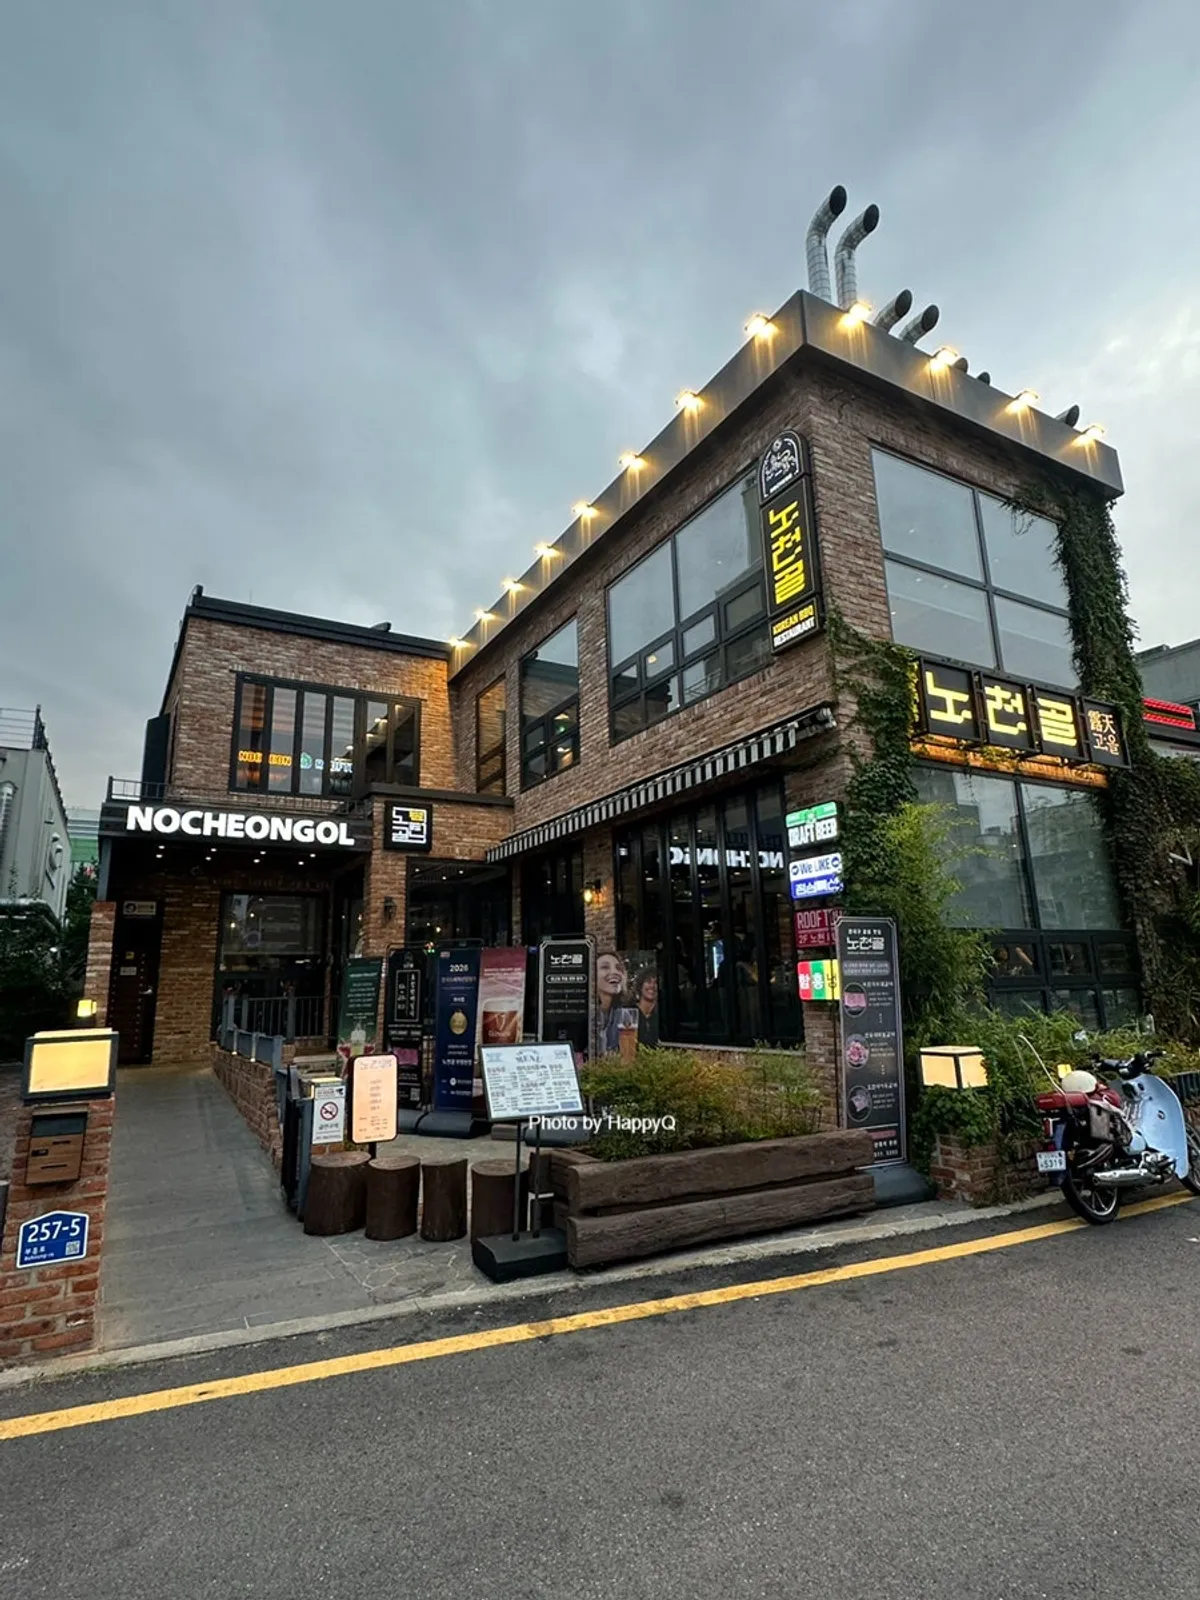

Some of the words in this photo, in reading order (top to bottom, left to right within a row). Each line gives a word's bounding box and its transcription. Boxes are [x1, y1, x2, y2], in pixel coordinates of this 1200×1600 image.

[769, 501, 806, 605] 노천골
[773, 615, 815, 648] RESTAURANT
[925, 671, 1077, 747] 노천골
[126, 805, 355, 846] NOCHEONGOL
[787, 823, 815, 847] DRAFT
[815, 817, 838, 840] BEER
[801, 861, 813, 875] We
[814, 857, 831, 872] LIKE
[27, 1218, 81, 1243] 257-5
